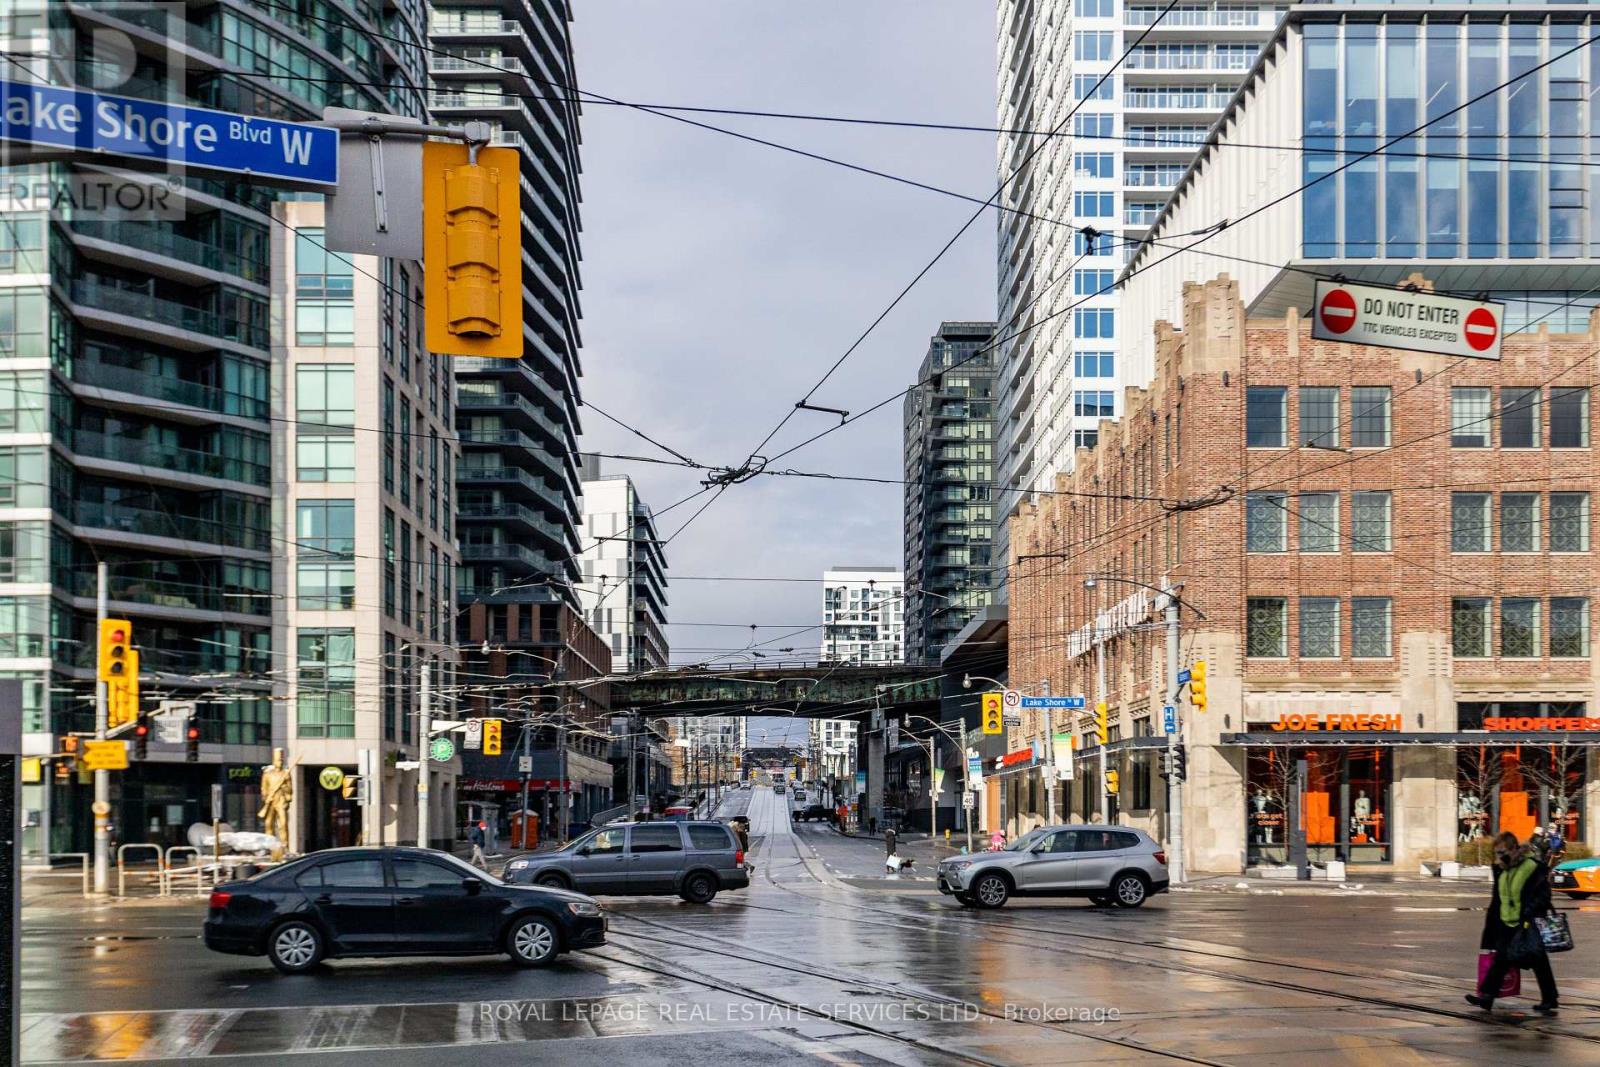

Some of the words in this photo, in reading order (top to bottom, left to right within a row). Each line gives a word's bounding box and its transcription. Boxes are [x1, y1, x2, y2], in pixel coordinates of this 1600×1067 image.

[0, 92, 82, 133] ake
[97, 101, 218, 152] Shore
[229, 121, 272, 145] Blvd
[281, 127, 313, 166] W
[1364, 298, 1383, 316] DO
[1387, 301, 1415, 319] NOT
[1418, 304, 1460, 325] ENTER
[1363, 322, 1378, 334] TTC
[1380, 324, 1417, 338] VEHICLES
[1419, 328, 1457, 343] EXCEPTED
[1271, 714, 1320, 731] JOE
[1326, 714, 1402, 731] FRESH
